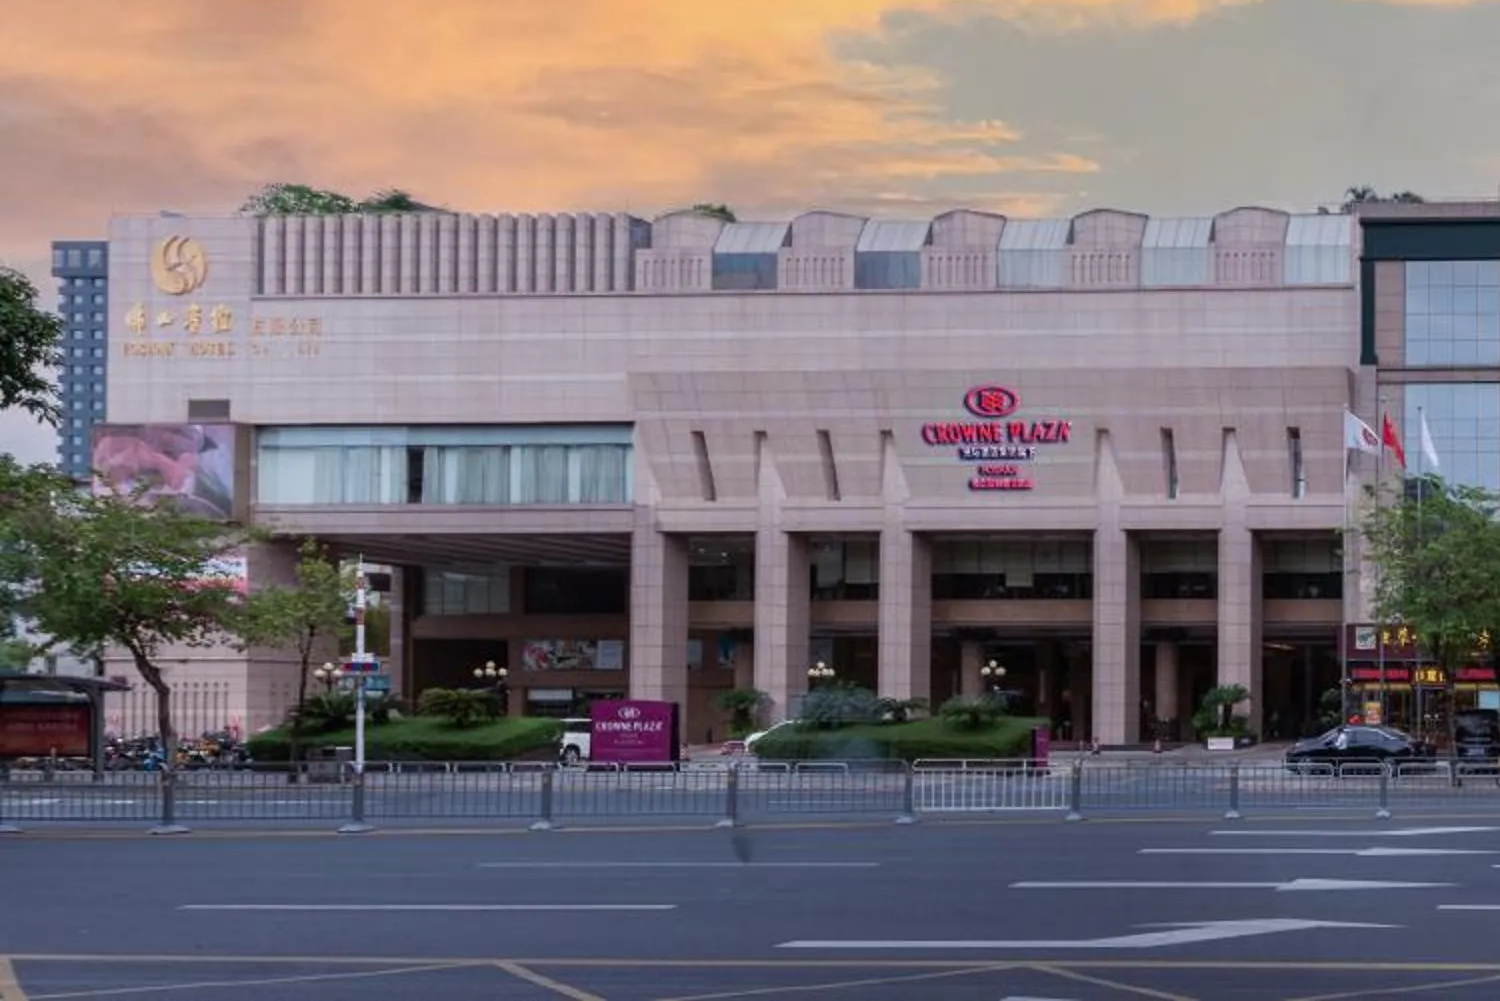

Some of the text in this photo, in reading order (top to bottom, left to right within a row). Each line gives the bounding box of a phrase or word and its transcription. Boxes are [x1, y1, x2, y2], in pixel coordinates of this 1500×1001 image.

[922, 420, 1072, 444] CROWNE PLAZA
[595, 721, 663, 732] CROWNE PLAZA
